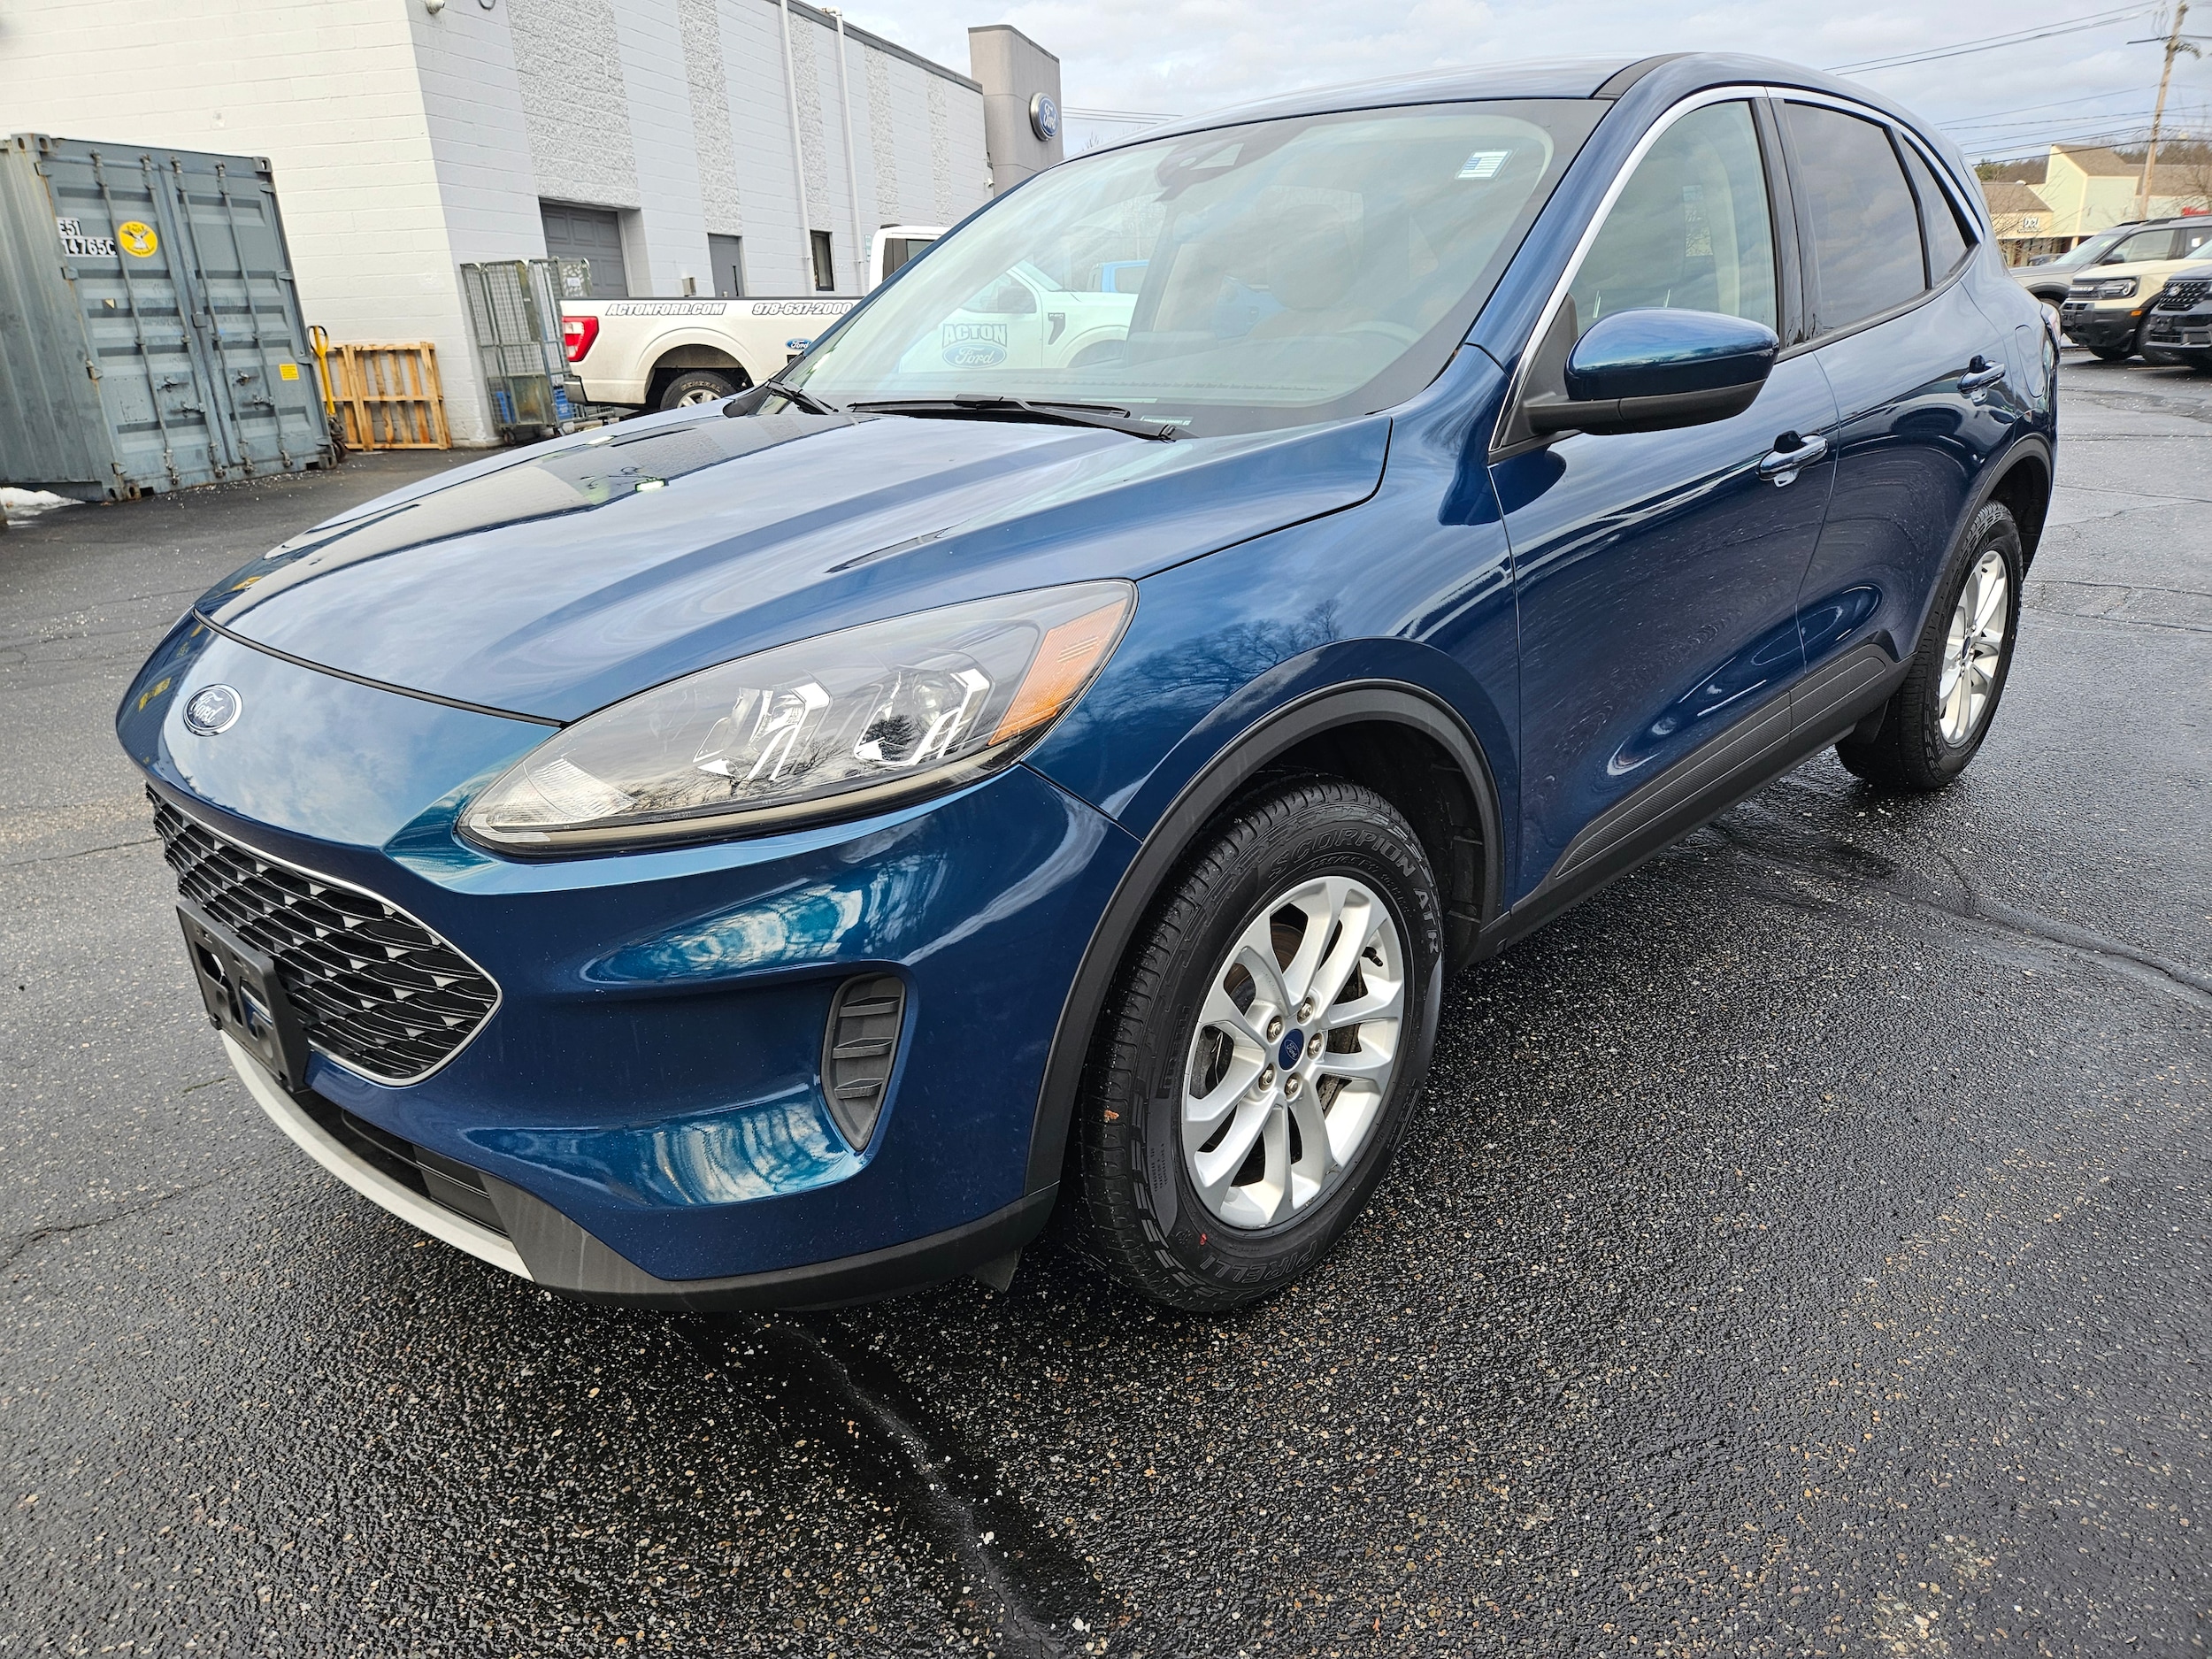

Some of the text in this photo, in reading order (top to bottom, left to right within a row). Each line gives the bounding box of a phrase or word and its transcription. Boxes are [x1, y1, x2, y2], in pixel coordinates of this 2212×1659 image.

[1043, 103, 1056, 130] Ford
[605, 303, 853, 316] ACTONFORD.COM 978-637-2000
[790, 340, 810, 349] Ford
[941, 323, 1008, 349] ACTON
[955, 346, 995, 365] Ford
[188, 690, 226, 724] Ford
[1268, 826, 1416, 883] SCORPION
[1413, 887, 1440, 954] ATR
[1286, 1042, 1298, 1058] Ford
[1199, 1240, 1317, 1284] PIRELLI
